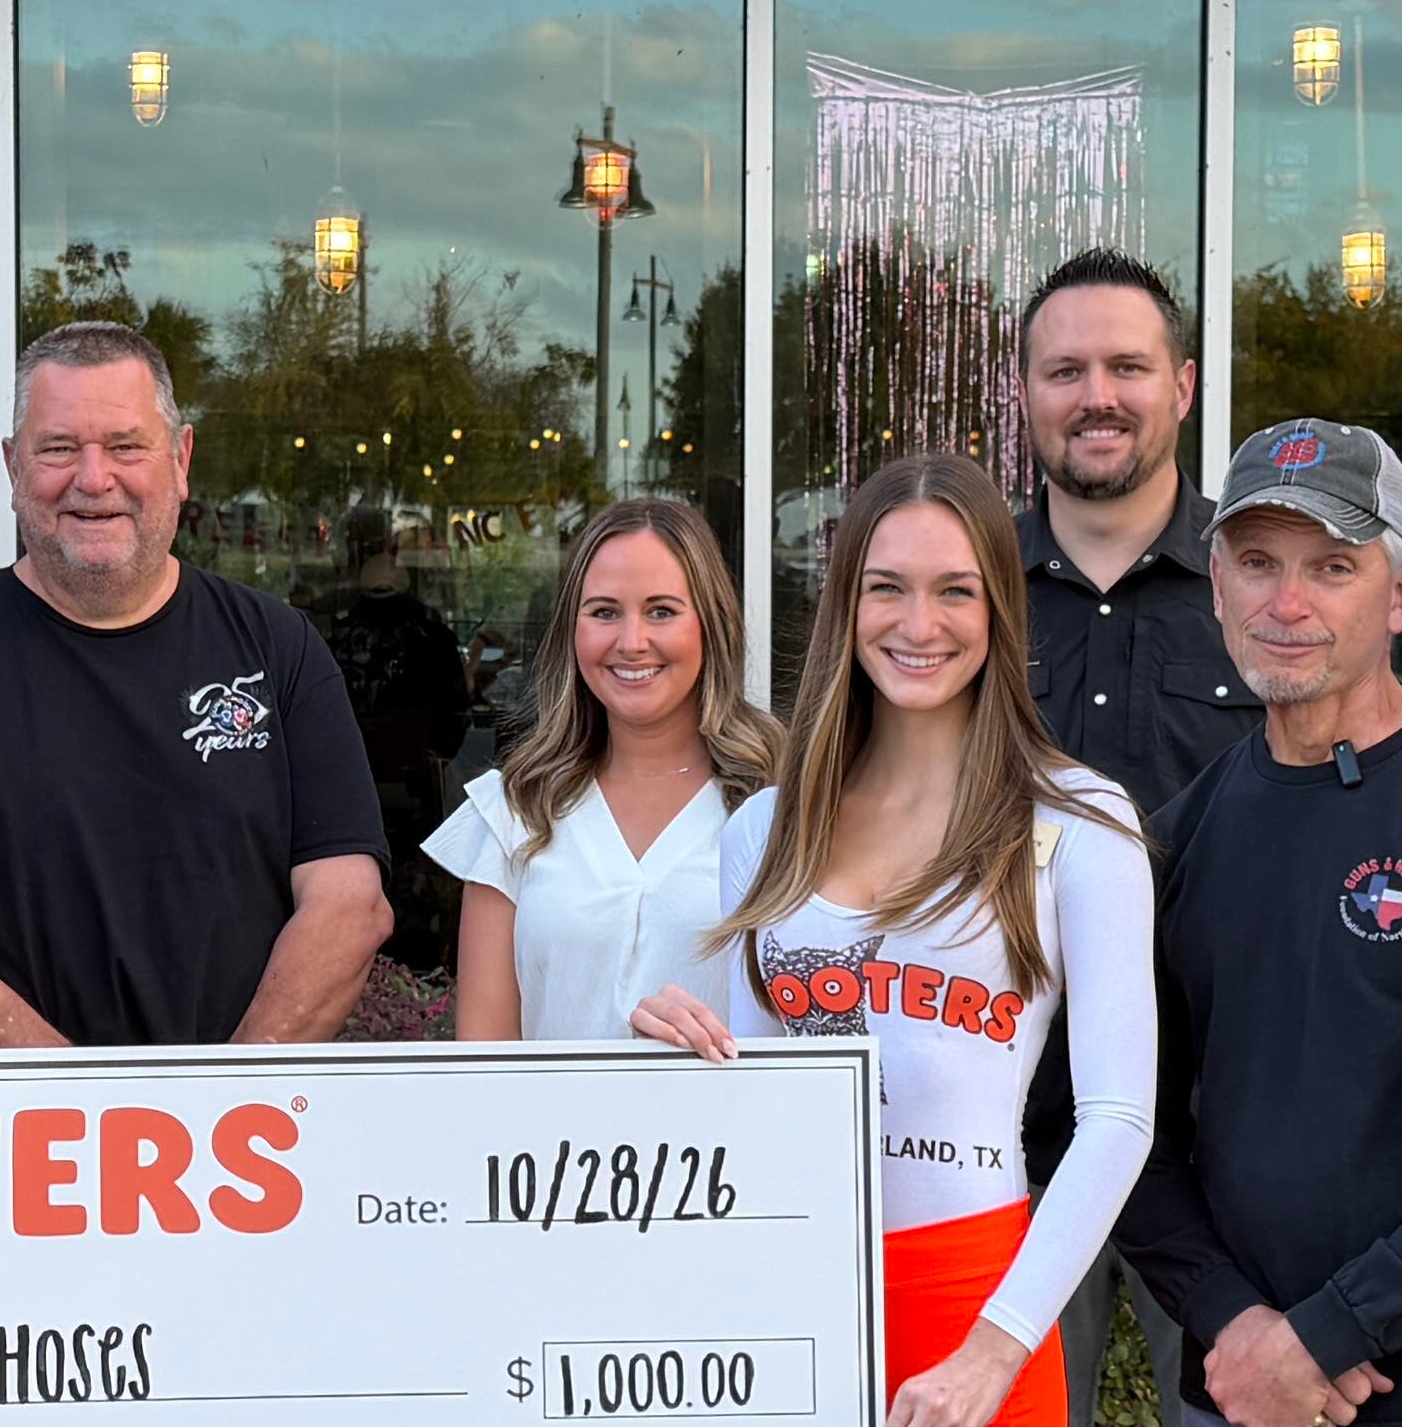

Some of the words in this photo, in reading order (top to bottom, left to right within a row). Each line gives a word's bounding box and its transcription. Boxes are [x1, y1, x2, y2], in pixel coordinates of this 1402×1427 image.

[182, 670, 269, 740] 25
[194, 731, 271, 763] years
[1343, 858, 1380, 890] GUNS
[768, 959, 1025, 1043] OOTERS
[881, 1135, 964, 1170] LAND,
[973, 1145, 1003, 1170] TX
[357, 1194, 449, 1226] Date:
[487, 1139, 737, 1234] 10/28/26
[506, 1355, 535, 1404] $
[561, 1350, 755, 1416] 1,000.00
